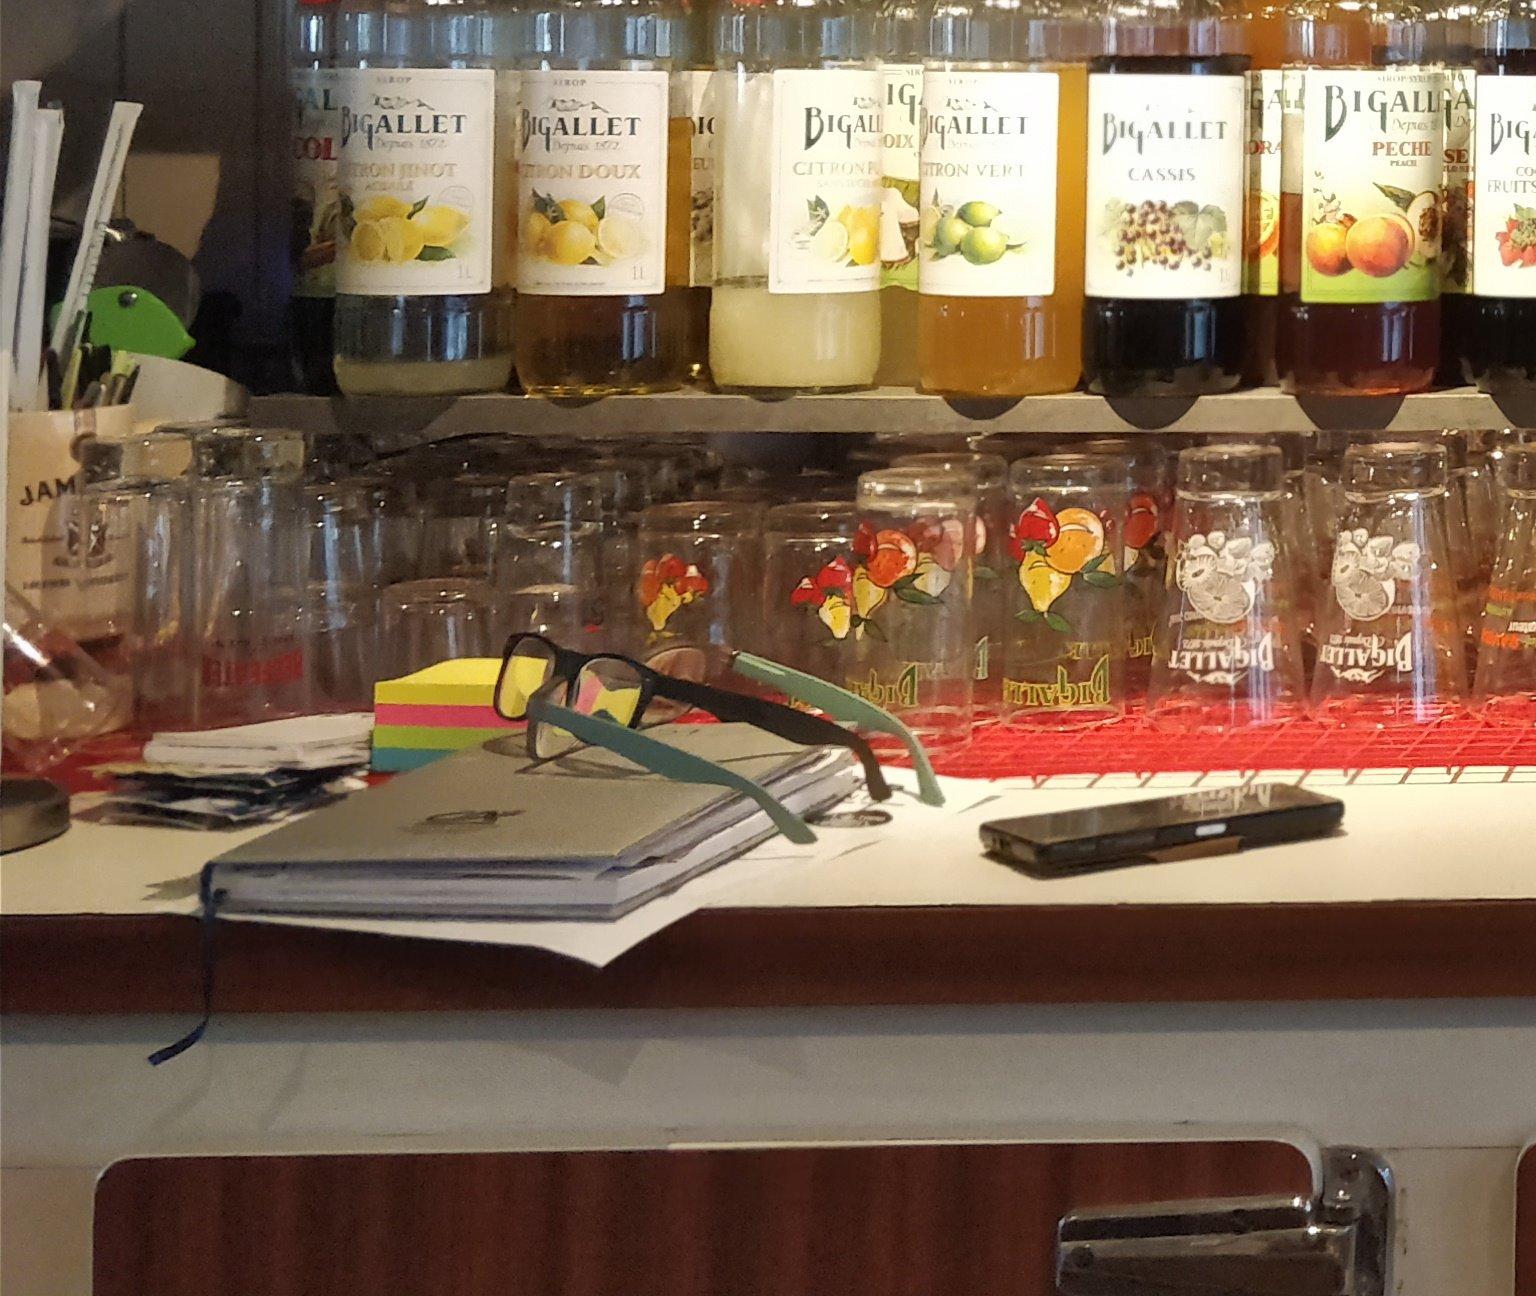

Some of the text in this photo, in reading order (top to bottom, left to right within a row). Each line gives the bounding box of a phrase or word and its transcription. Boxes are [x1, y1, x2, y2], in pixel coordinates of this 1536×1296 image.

[340, 105, 468, 151] BIGALLET
[520, 108, 642, 153] BIGALLET
[1102, 112, 1228, 156] BIGALLET
[577, 163, 642, 179] DOUX
[1127, 167, 1197, 182] CASSIS
[1168, 631, 1275, 671] BIGALLET
[1319, 632, 1413, 672] BIGALLET
